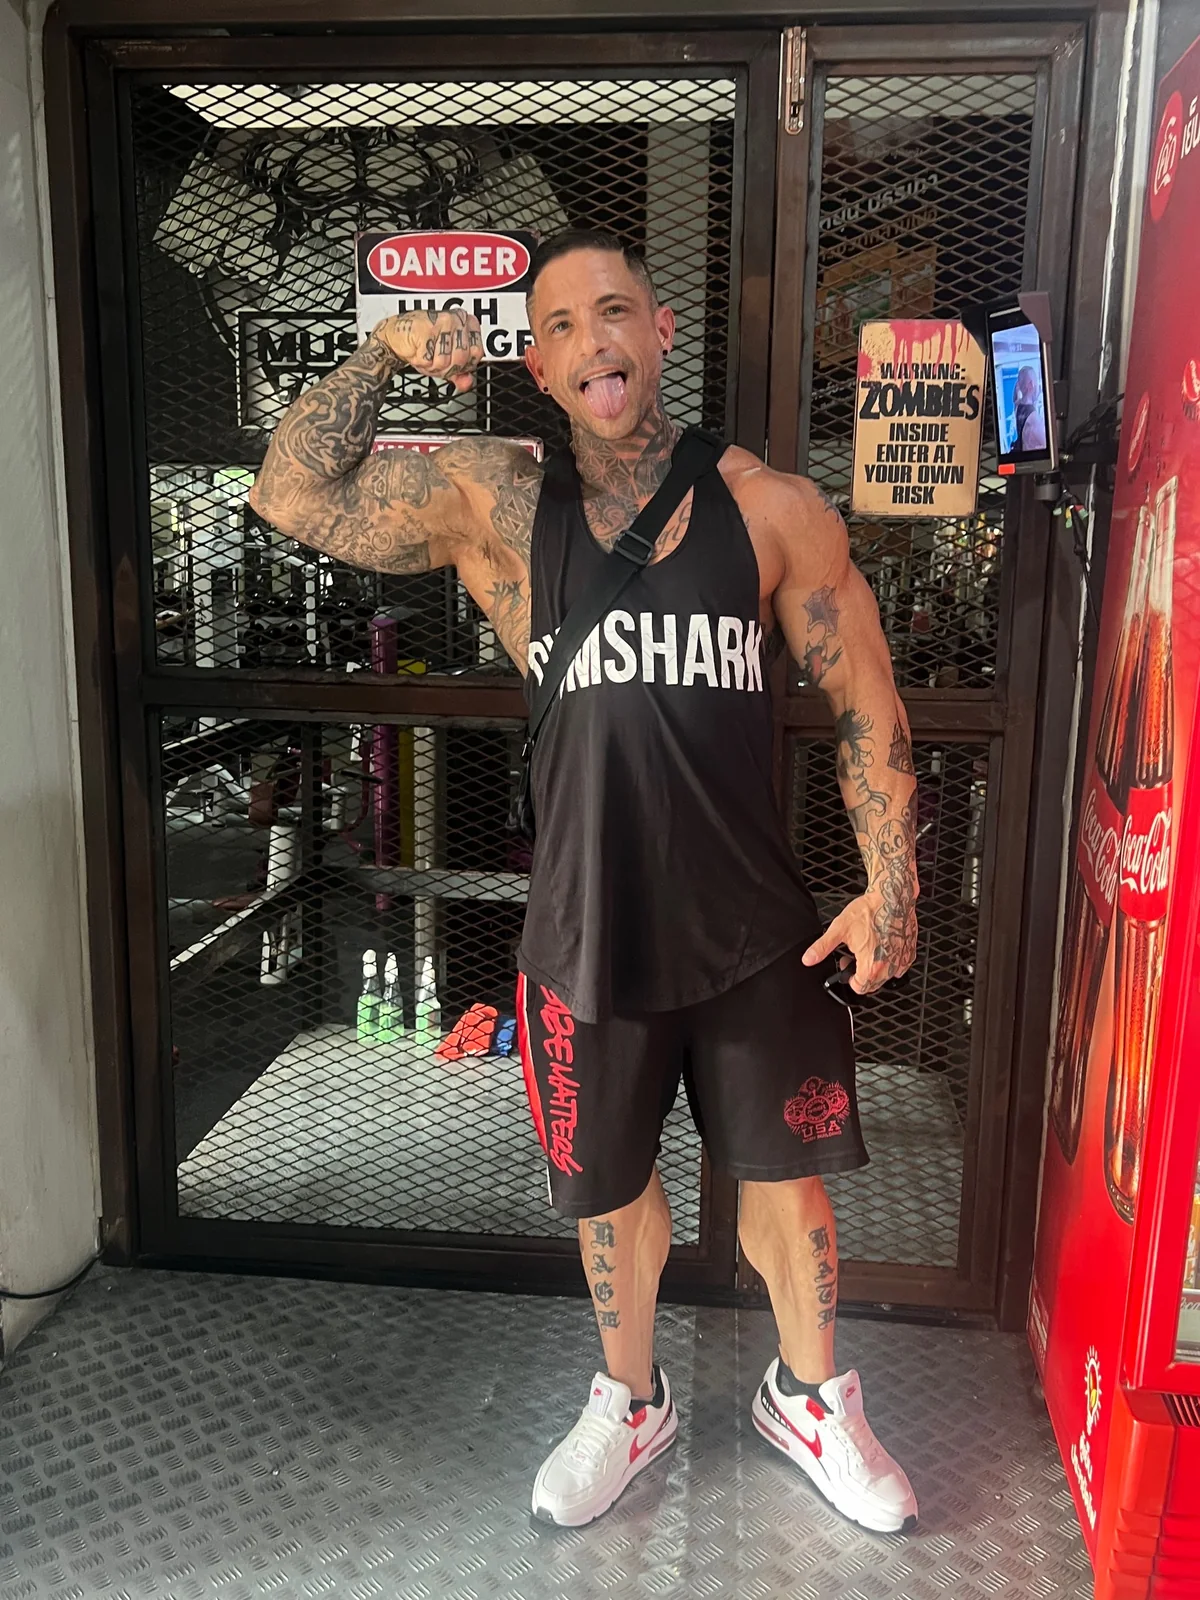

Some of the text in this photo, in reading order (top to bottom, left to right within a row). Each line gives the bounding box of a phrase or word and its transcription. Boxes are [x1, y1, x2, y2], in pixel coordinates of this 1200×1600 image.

[379, 246, 517, 277] DANGER
[258, 331, 358, 361] MUS
[880, 362, 966, 380] WARNING:
[859, 381, 980, 420] ZOMBIES
[889, 422, 950, 442] INSIDE
[876, 444, 956, 464] ENTER AT
[864, 464, 964, 484] YOUR OWN
[892, 485, 936, 504] RISK
[528, 609, 763, 700] GMSHARK
[802, 1119, 841, 1138] USA
